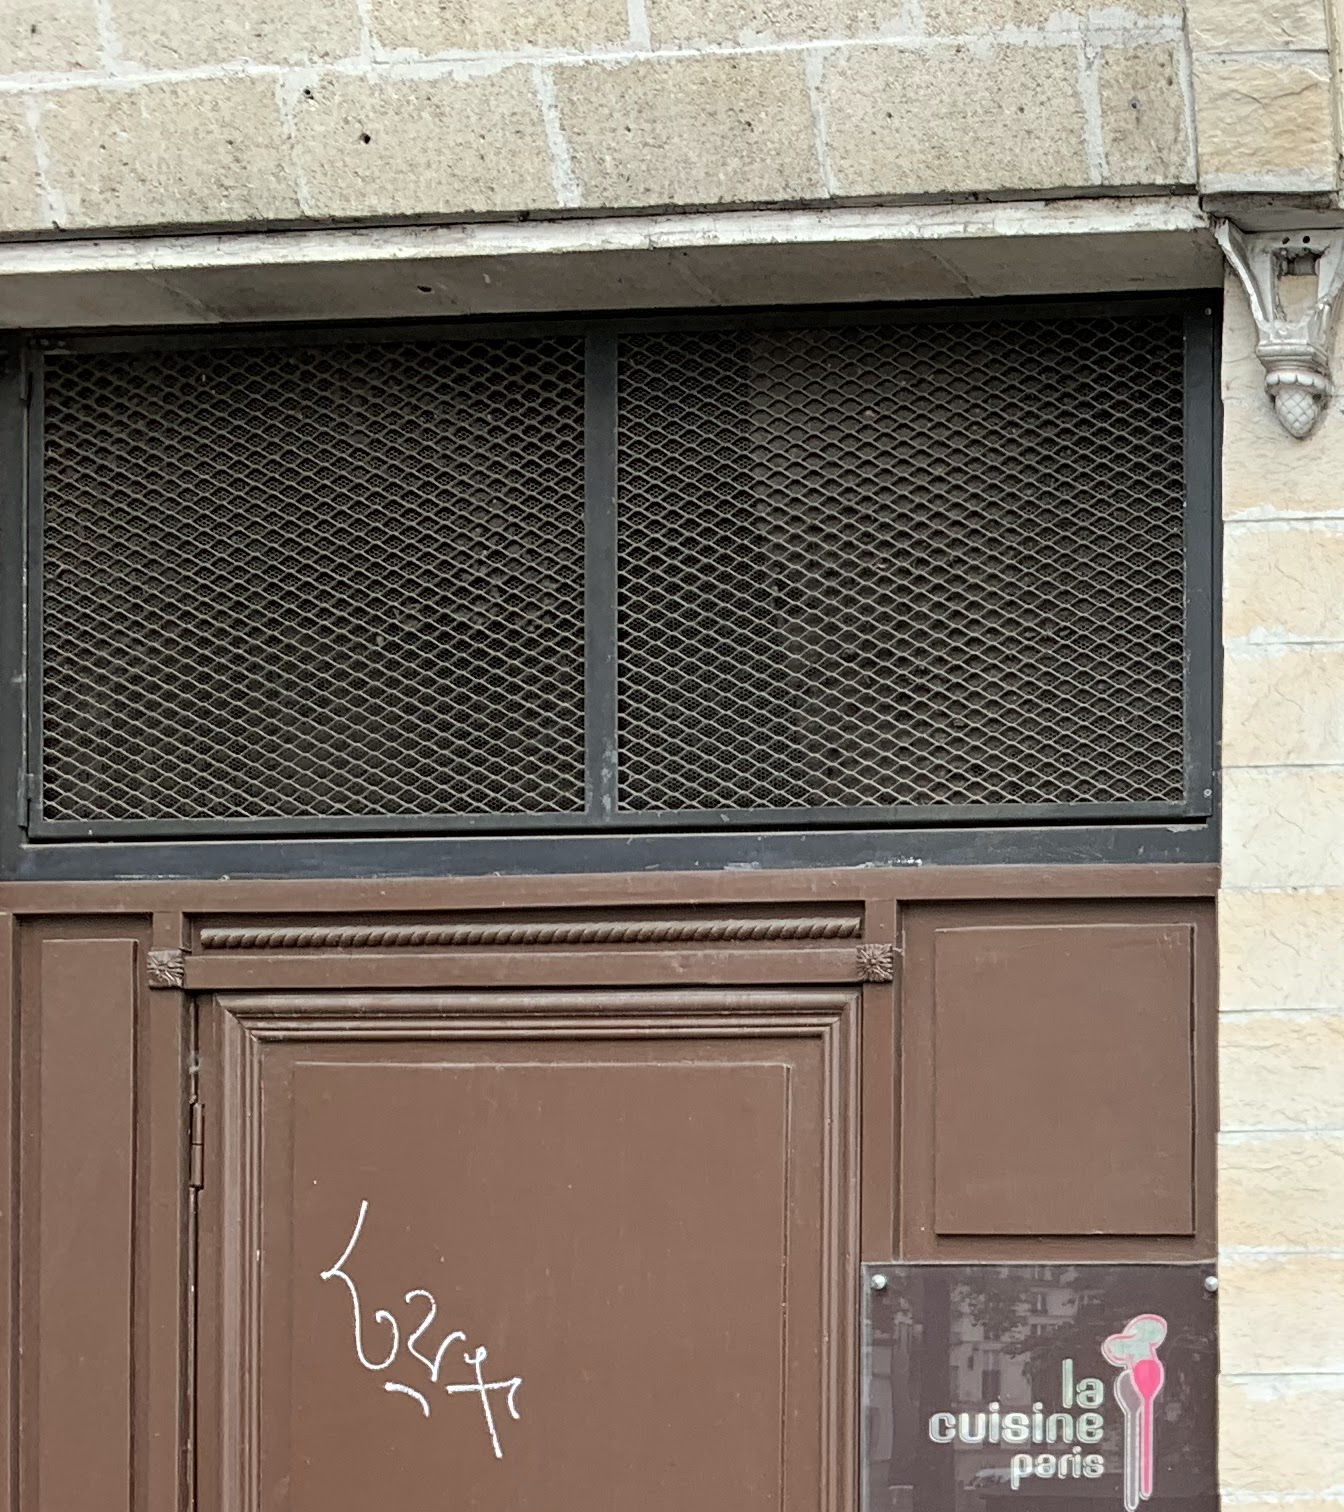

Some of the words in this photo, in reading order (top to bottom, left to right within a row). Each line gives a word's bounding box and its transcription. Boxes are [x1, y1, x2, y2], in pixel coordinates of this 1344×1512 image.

[1062, 1359, 1104, 1408] la
[929, 1403, 1104, 1444] cuisine
[1010, 1446, 1104, 1490] paris
